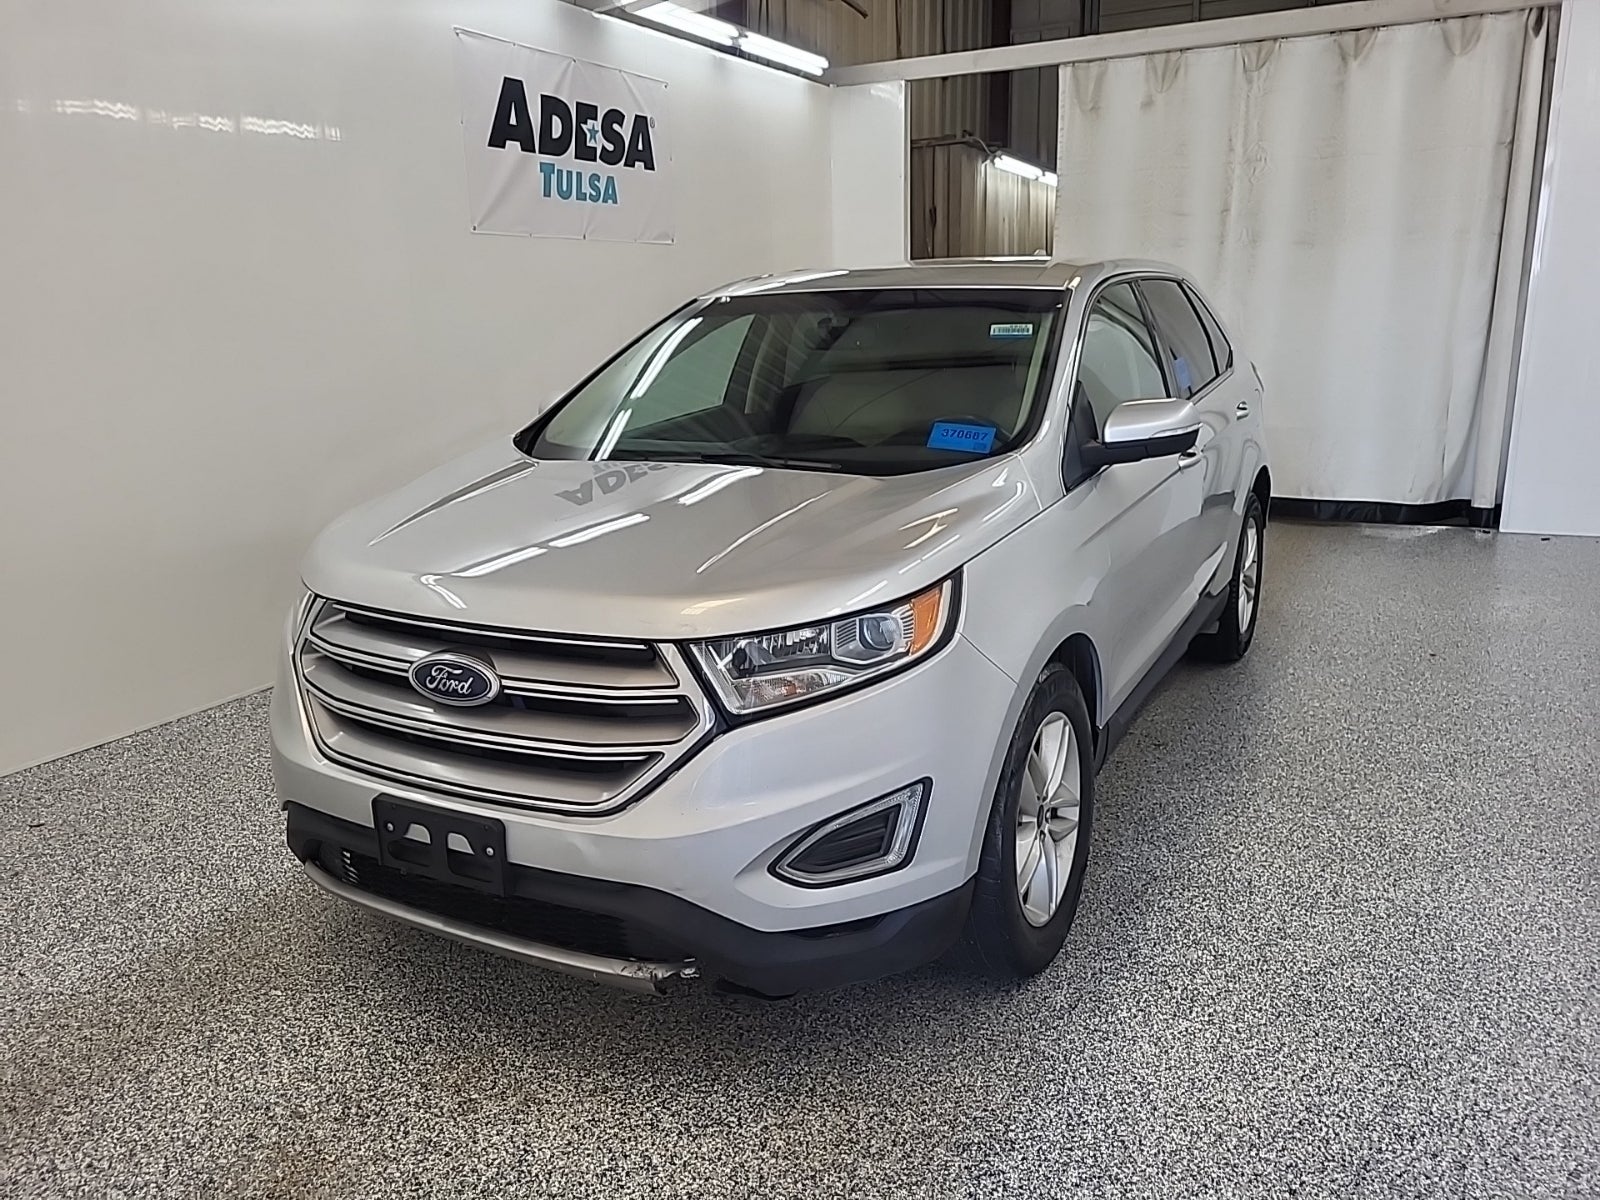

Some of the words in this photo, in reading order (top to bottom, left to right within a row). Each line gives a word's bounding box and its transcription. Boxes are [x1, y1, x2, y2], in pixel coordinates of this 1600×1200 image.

[487, 76, 655, 171] ADESA
[539, 162, 618, 205] TULSA
[426, 665, 474, 695] Ford
